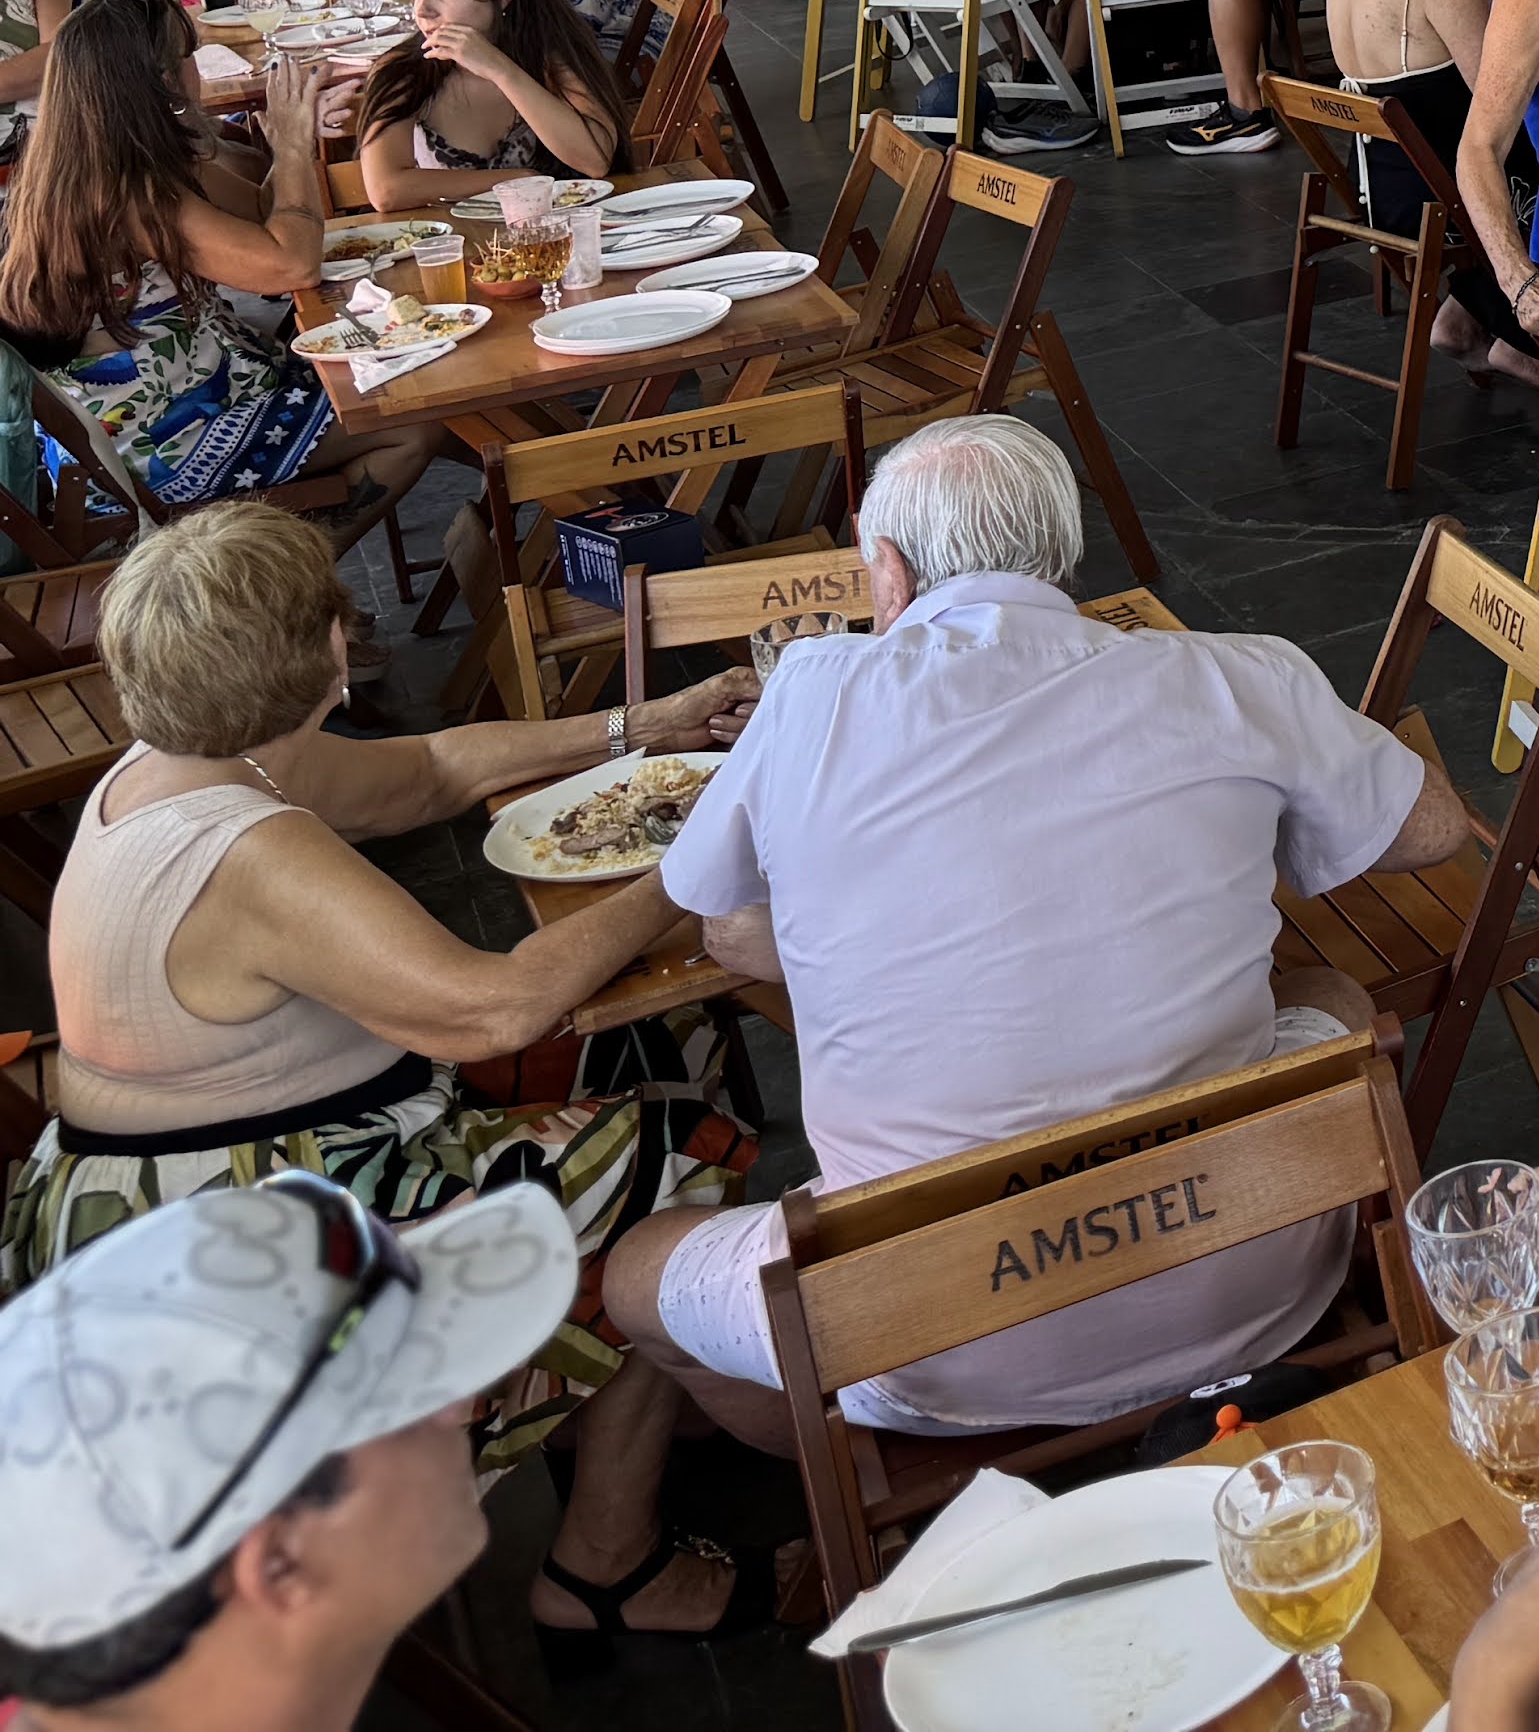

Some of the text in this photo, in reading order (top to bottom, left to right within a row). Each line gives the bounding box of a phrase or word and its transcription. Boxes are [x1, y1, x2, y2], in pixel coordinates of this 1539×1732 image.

[1310, 96, 1360, 123] AMSTEL
[976, 172, 1017, 206] AMSTEL
[612, 422, 747, 468] AMSTEL
[762, 568, 868, 610] AMST
[1469, 581, 1526, 653] AMSTEL
[991, 1174, 1217, 1292] AMSTEL
